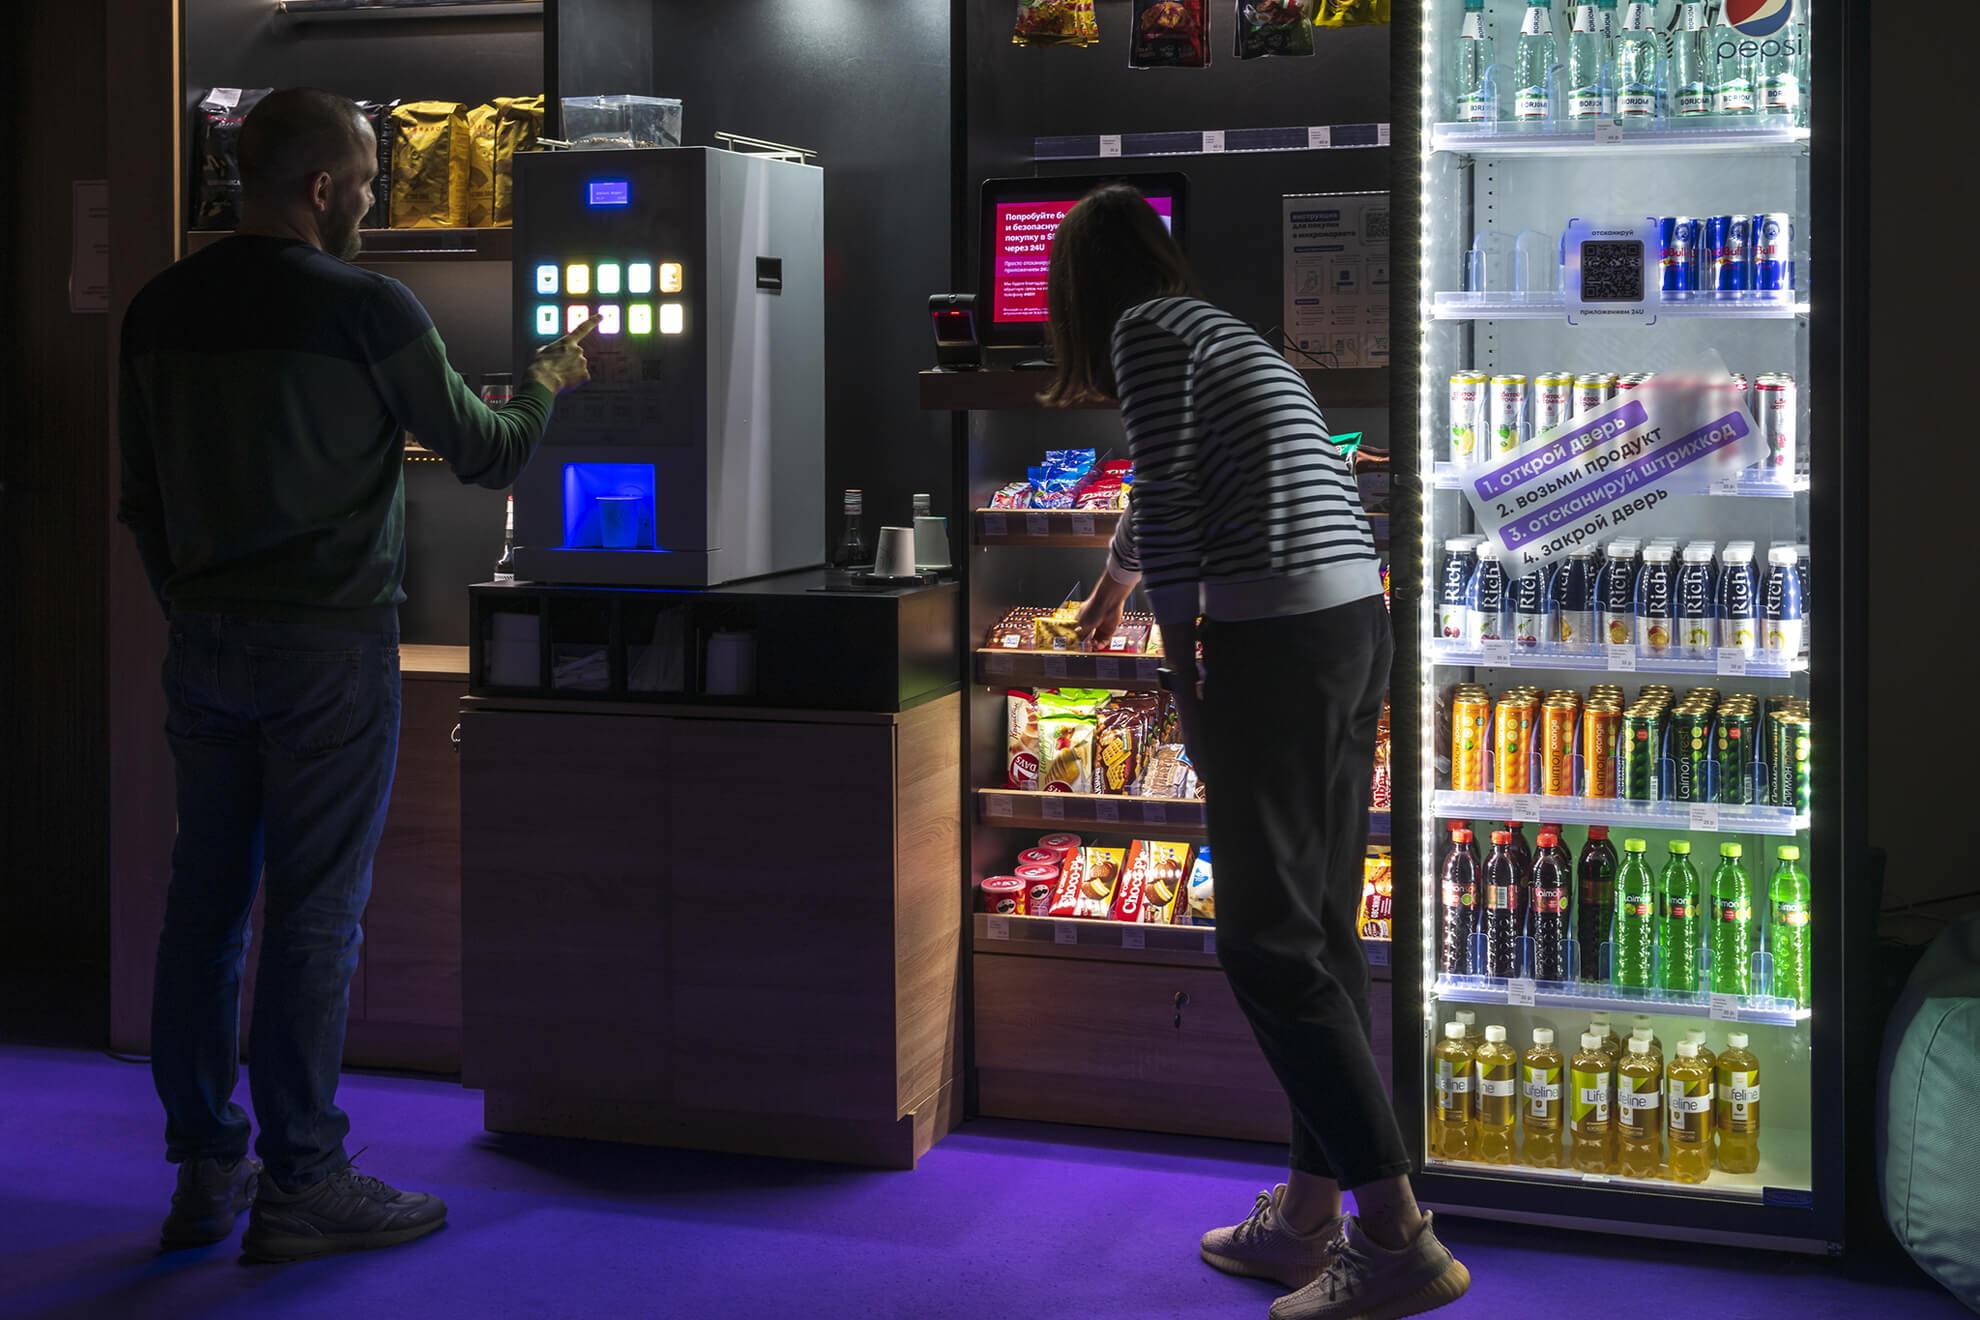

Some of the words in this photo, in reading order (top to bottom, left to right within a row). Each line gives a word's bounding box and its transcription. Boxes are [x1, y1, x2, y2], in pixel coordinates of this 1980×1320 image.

[1533, 8, 1541, 34] BORJOMI
[1716, 33, 1803, 65] pepsi
[1005, 212, 1055, 223] Попробуйте
[1004, 245, 1029, 253] через
[1030, 244, 1046, 252] 24U
[1005, 234, 1039, 243] покупку
[1482, 480, 1500, 495] 1.
[1500, 443, 1567, 487] открой
[1569, 415, 1627, 456] дверь
[1496, 502, 1515, 518] 2.
[1515, 468, 1583, 510] возьми
[1584, 426, 1662, 476] продукт
[1507, 527, 1527, 543] 3.
[1528, 469, 1639, 533] отсканируй
[1639, 423, 1737, 477] штрихкод
[1523, 550, 1540, 566] 4.
[1541, 514, 1610, 558] закрой
[1611, 486, 1669, 526] дверь
[1445, 559, 1462, 600] Rich
[1483, 564, 1500, 608] Rich
[1610, 567, 1626, 609] Rich
[1650, 570, 1667, 614] Rich
[1687, 570, 1703, 614] Rich
[1732, 570, 1748, 615] Rich
[1767, 571, 1784, 616] Rich
[1551, 719, 1561, 750] orange
[1595, 723, 1605, 754] orange
[1015, 755, 1038, 772] DAYS
[1525, 1081, 1560, 1099] Lifeline
